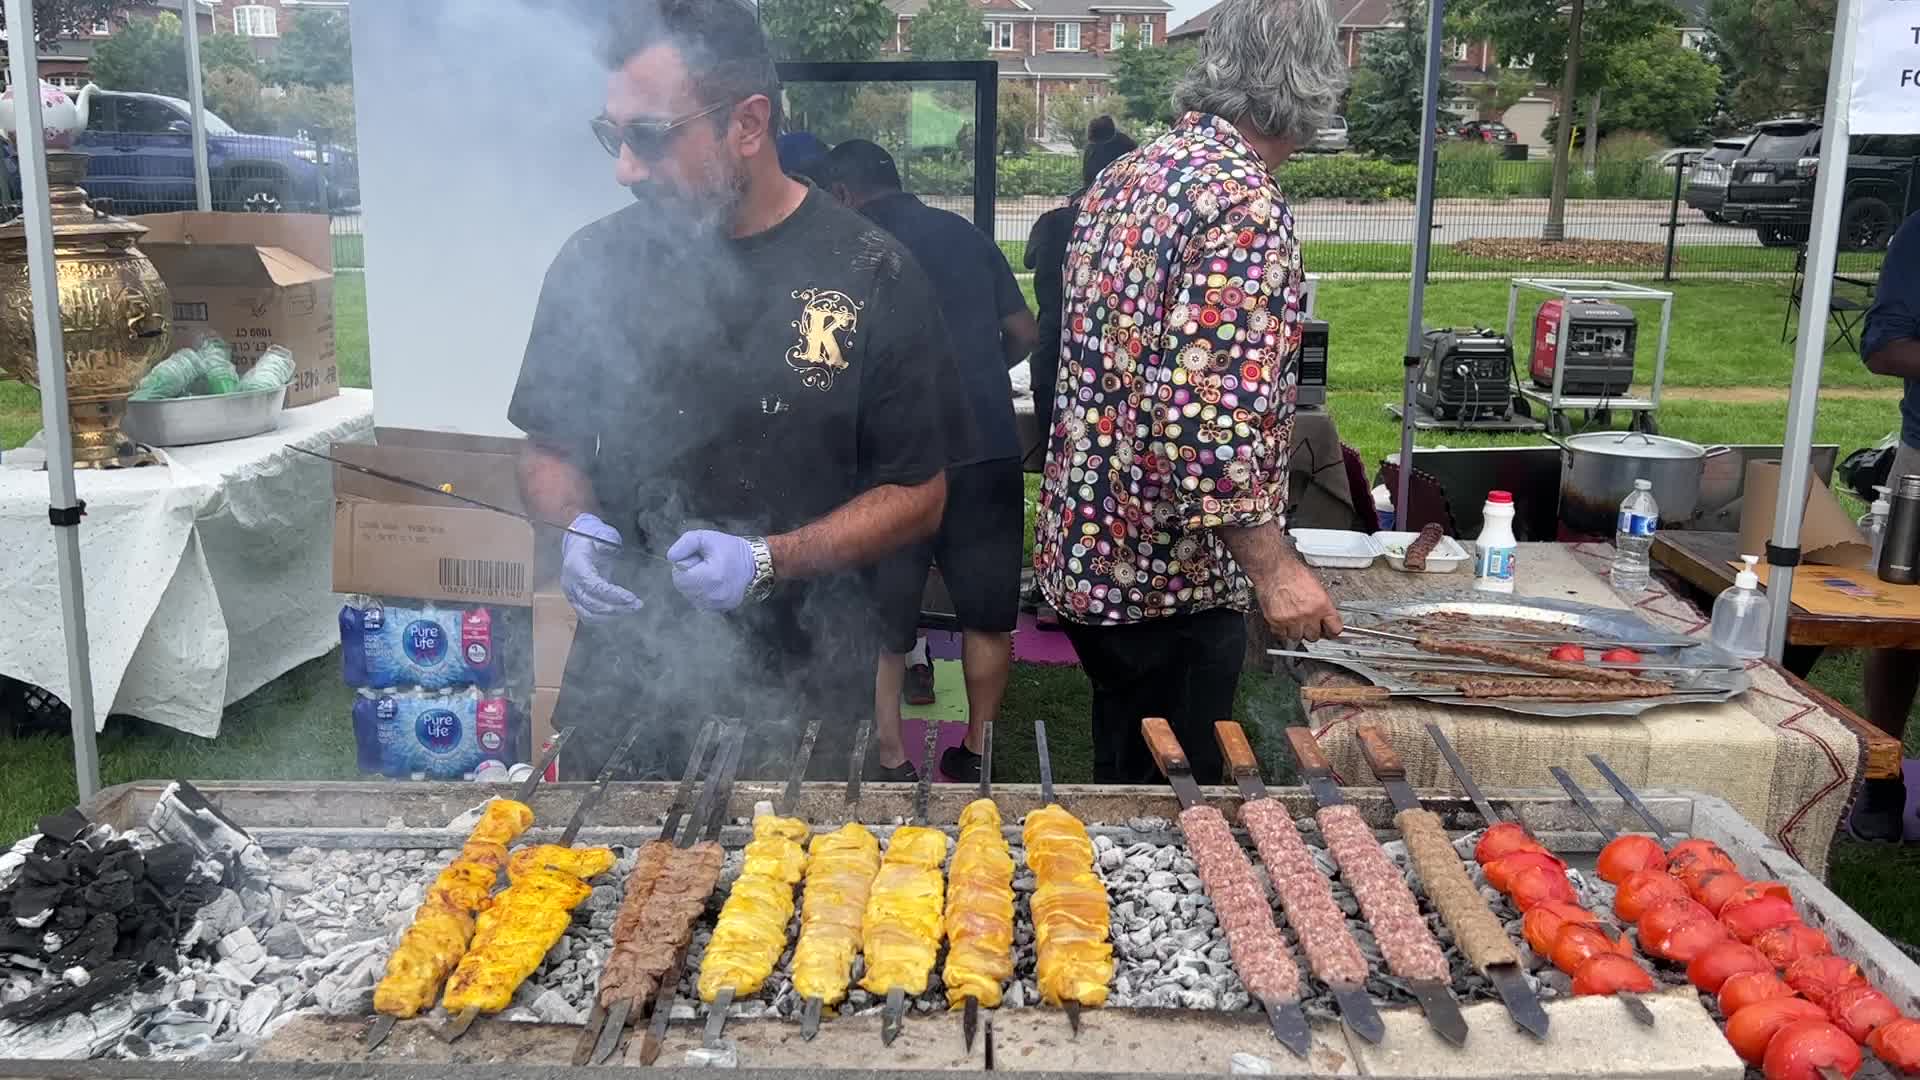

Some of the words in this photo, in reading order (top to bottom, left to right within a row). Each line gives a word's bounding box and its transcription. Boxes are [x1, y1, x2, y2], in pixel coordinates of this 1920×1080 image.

[235, 327, 248, 337] CT
[249, 327, 272, 337] 1000
[797, 300, 859, 371] K
[364, 610, 380, 621] 24
[410, 625, 439, 639] Pure
[415, 638, 435, 650] Life
[377, 699, 393, 710] 24
[423, 714, 453, 727] Pure
[428, 725, 449, 737] Life
